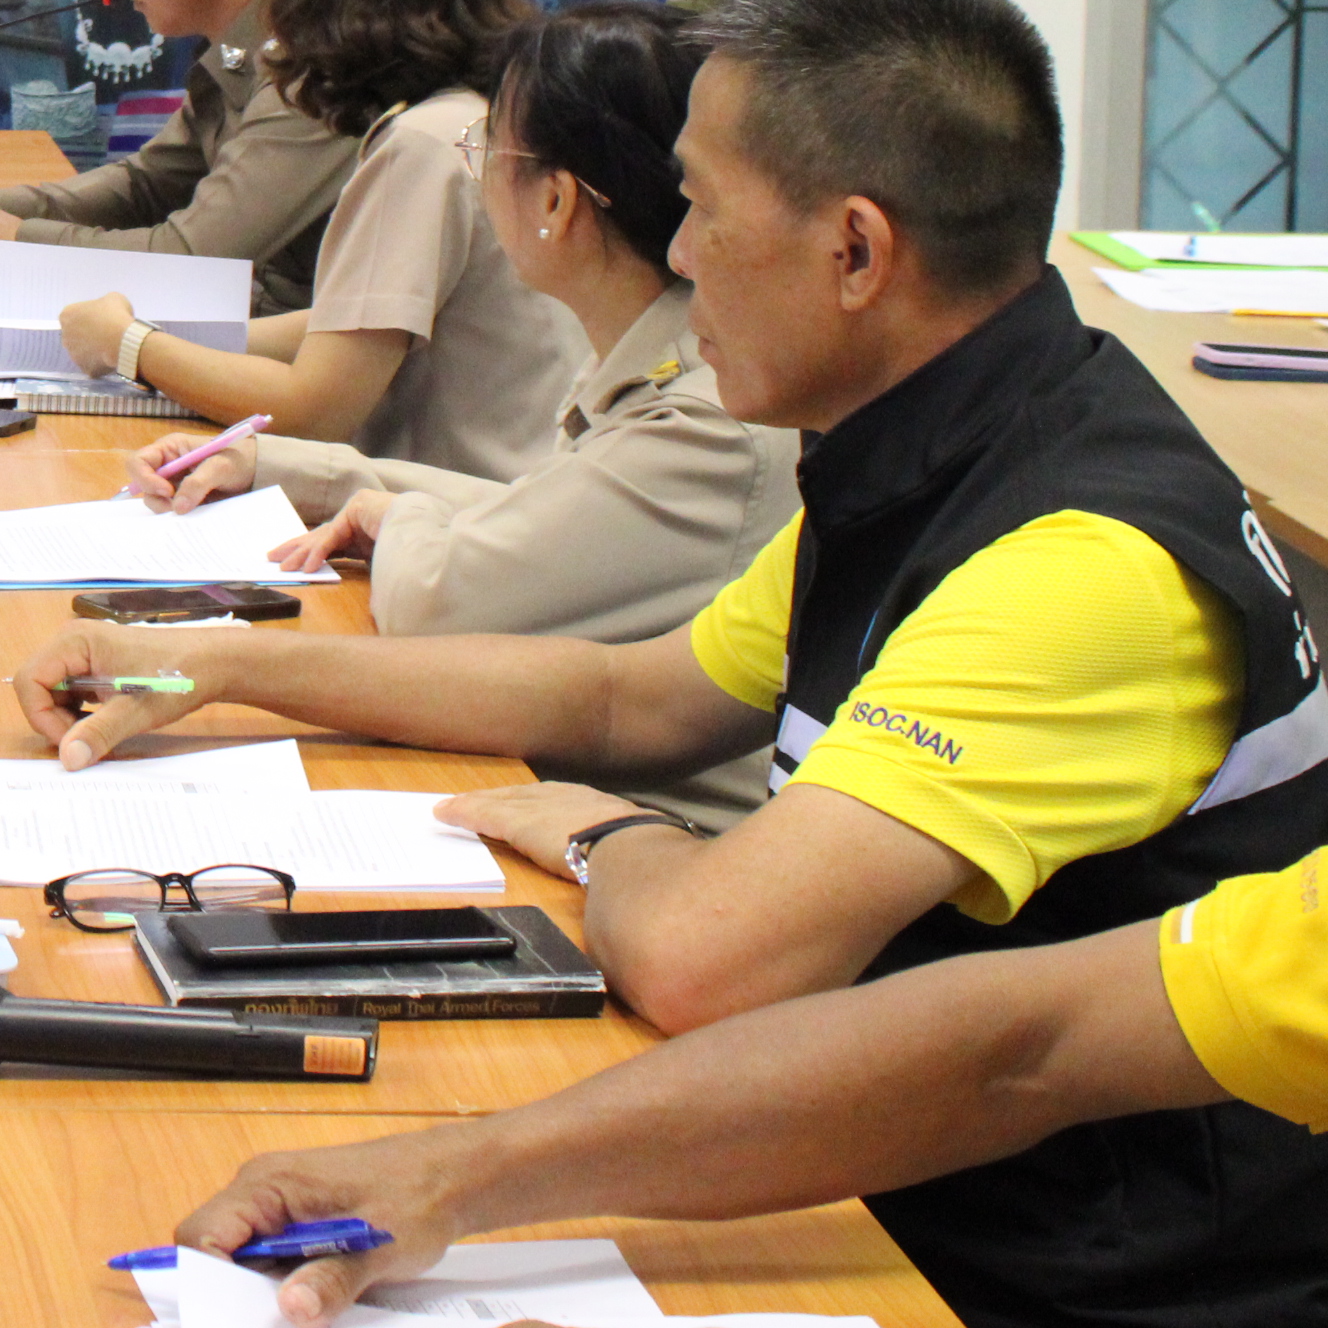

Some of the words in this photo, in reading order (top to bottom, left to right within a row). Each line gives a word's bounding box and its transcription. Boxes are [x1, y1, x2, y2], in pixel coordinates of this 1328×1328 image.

[848, 701, 964, 765] ISOC.NAN
[362, 1001, 402, 1016] Royal
[408, 1001, 435, 1017] Thai
[439, 1000, 490, 1014] Armed
[492, 998, 541, 1014] Forces
